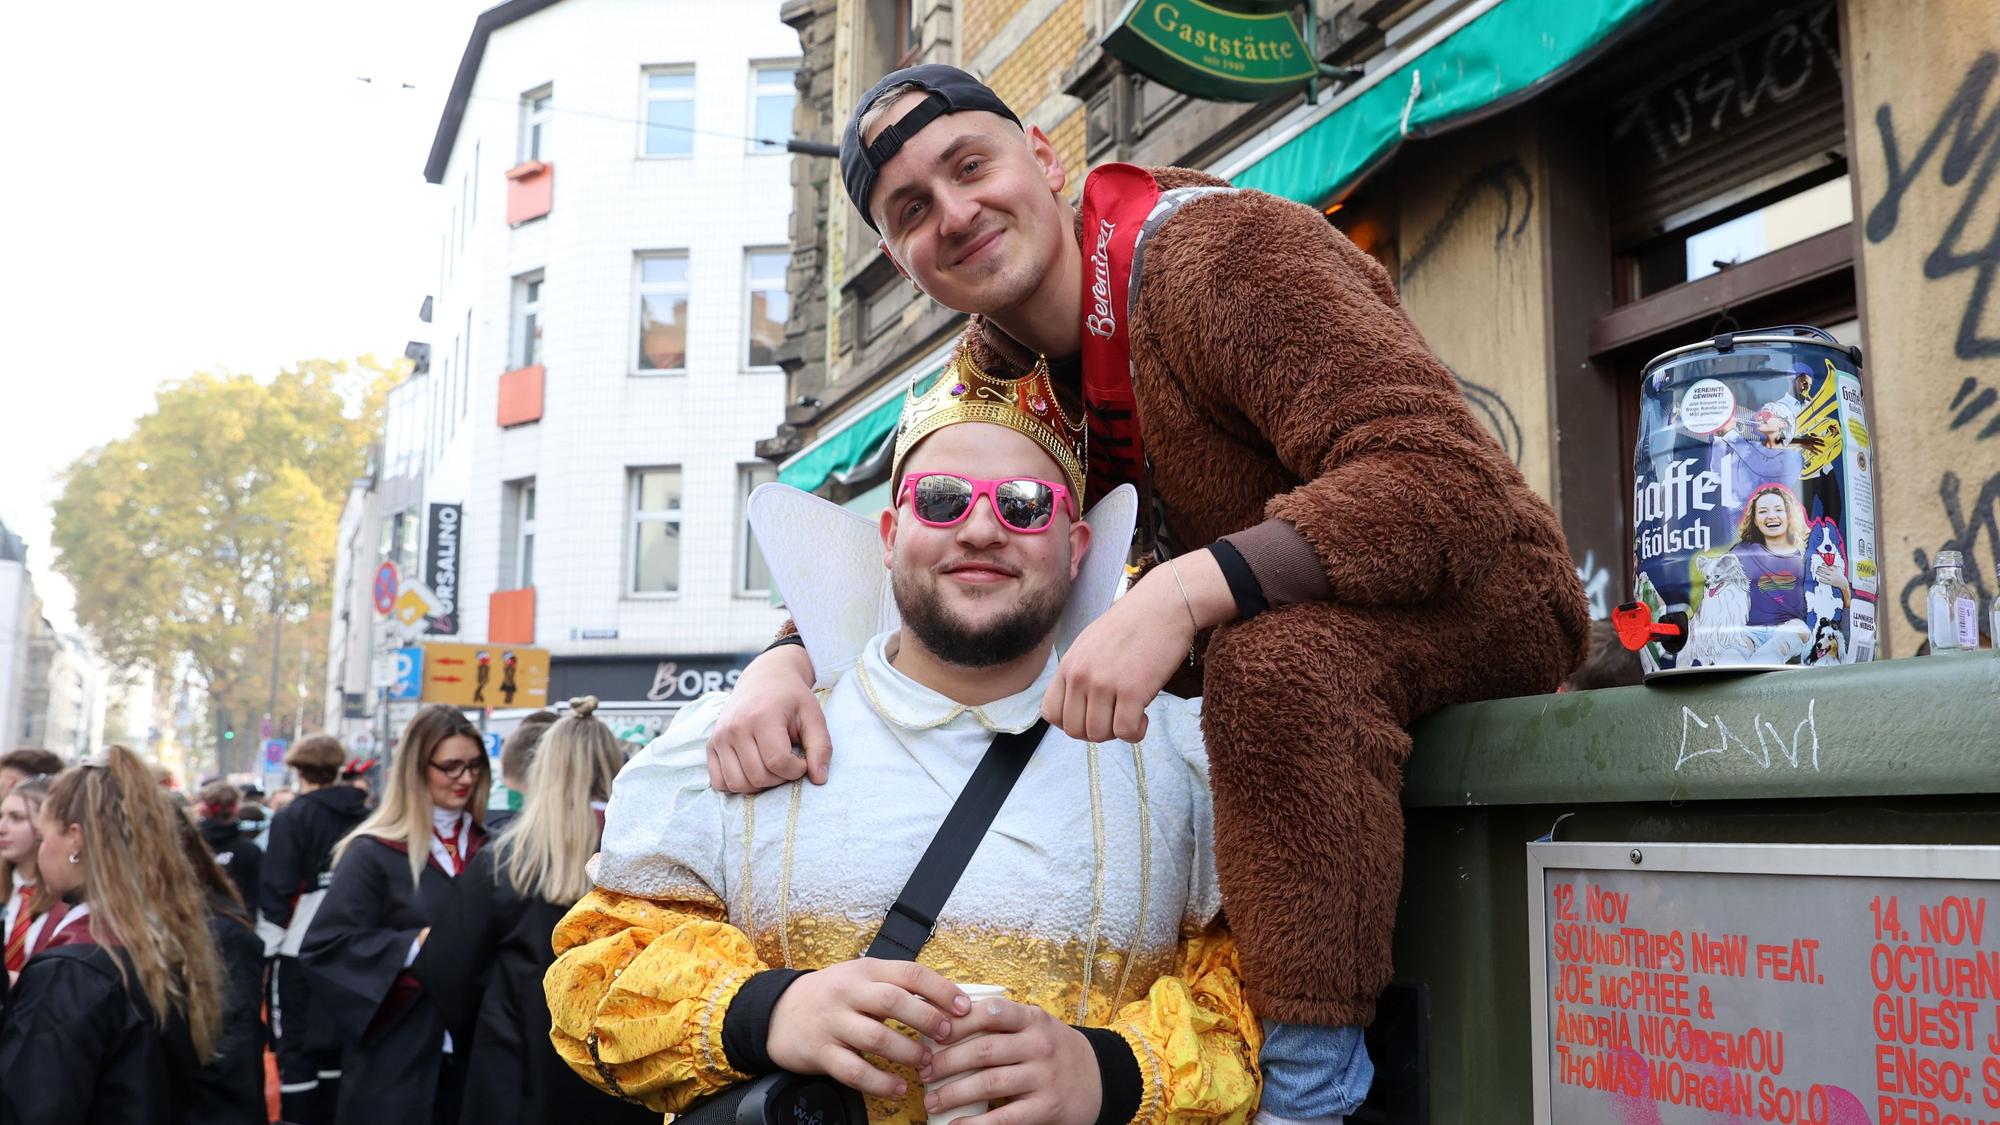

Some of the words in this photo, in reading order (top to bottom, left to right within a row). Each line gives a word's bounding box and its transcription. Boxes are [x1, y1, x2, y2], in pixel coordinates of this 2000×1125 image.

[1154, 2, 1295, 61] Gaststätte
[1554, 883, 1580, 921] 12.
[1870, 895, 1909, 941] 14.
[1919, 895, 1986, 946] NOV
[1553, 922, 1685, 973] SOUNDTRIPS
[1756, 938, 1824, 985] FEAT.
[1554, 963, 1594, 1005] JOE
[1698, 984, 1715, 1020] &
[1638, 1013, 1784, 1076] NICODEMOU
[1873, 993, 1979, 1051] GUEST
[1555, 1044, 1642, 1098] THOMAS
[1648, 1058, 1753, 1118] MORGAN
[1758, 1075, 1829, 1125] SOLO
[1876, 1044, 1972, 1104] ENSO:
